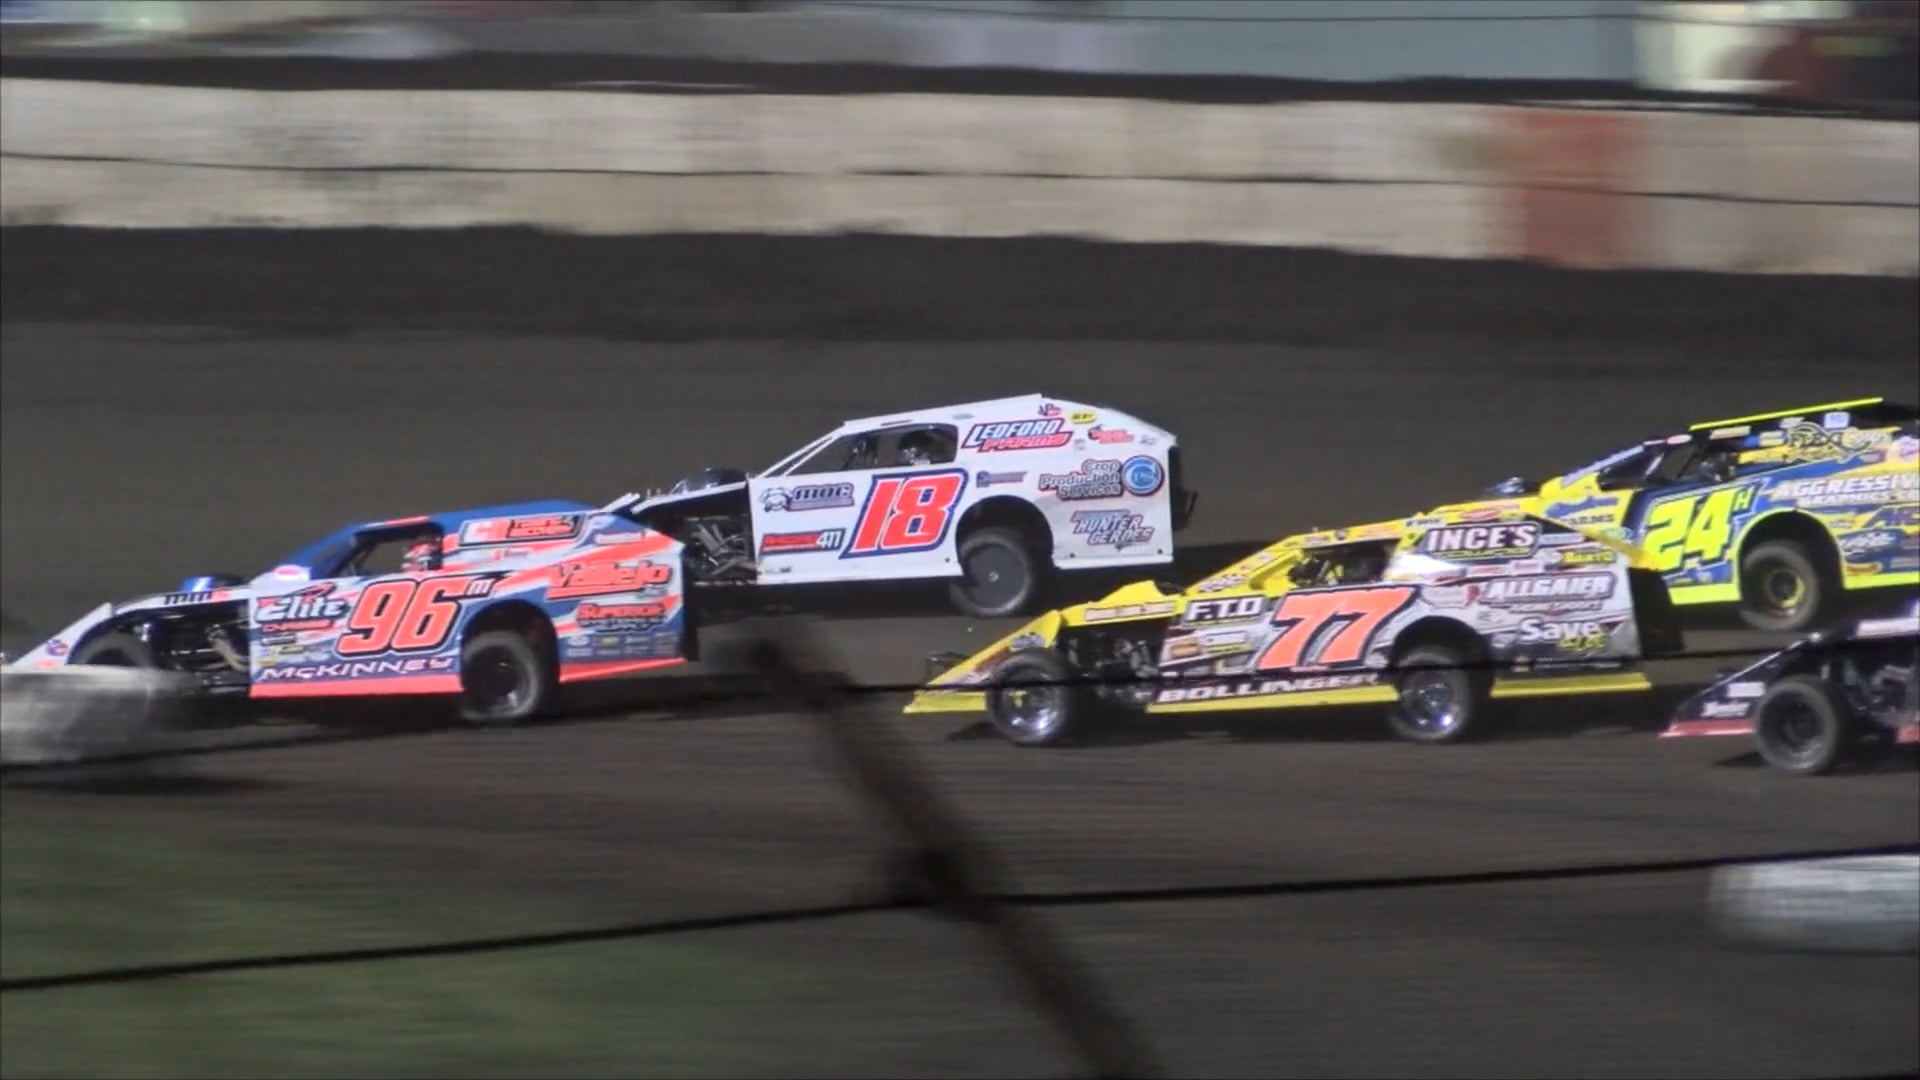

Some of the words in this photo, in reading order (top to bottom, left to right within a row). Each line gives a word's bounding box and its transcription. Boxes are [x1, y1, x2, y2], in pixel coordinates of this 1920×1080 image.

[1041, 471, 1120, 489] Production
[1084, 460, 1119, 474] Crop
[1060, 484, 1120, 499] Services
[1733, 485, 1754, 511] H
[846, 470, 963, 553] 18
[1074, 514, 1143, 534] HUNTER
[1426, 524, 1536, 552] INCE'S
[1642, 488, 1741, 573] 24
[1488, 574, 1610, 600] ALLGAIER
[256, 595, 346, 623] Elite
[337, 576, 463, 656] 96
[1257, 586, 1413, 671] 77
[1518, 617, 1602, 643] Save
[1157, 672, 1379, 703] BOLLINGER
